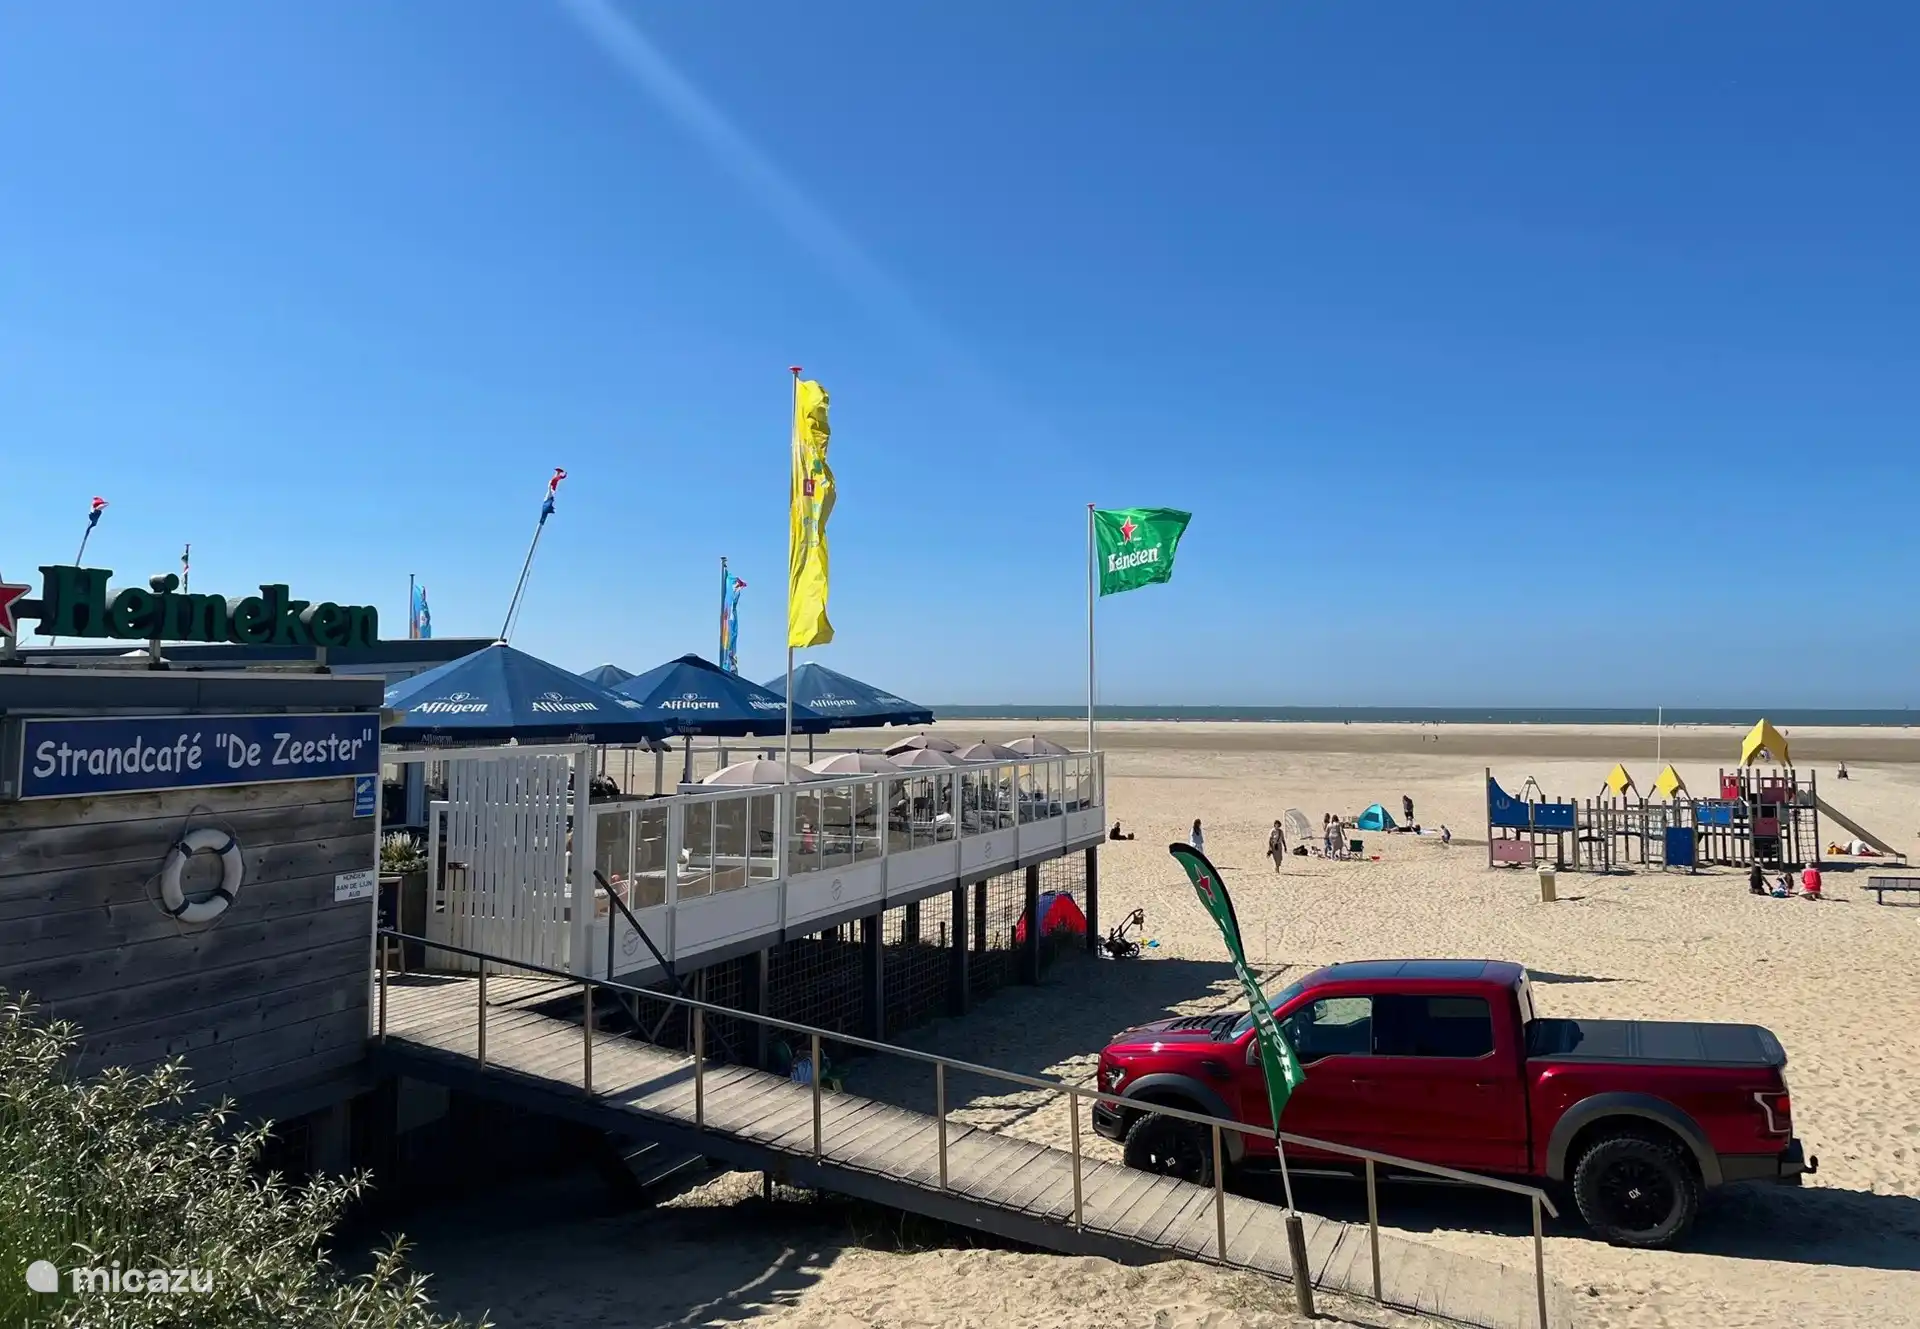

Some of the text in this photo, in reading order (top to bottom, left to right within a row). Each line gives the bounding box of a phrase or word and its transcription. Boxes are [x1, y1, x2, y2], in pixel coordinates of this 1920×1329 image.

[34, 565, 379, 648] Heineken
[409, 702, 488, 714] Affligem
[657, 701, 720, 710] Affligem
[33, 728, 373, 778] Strandcafé "De Zeester"
